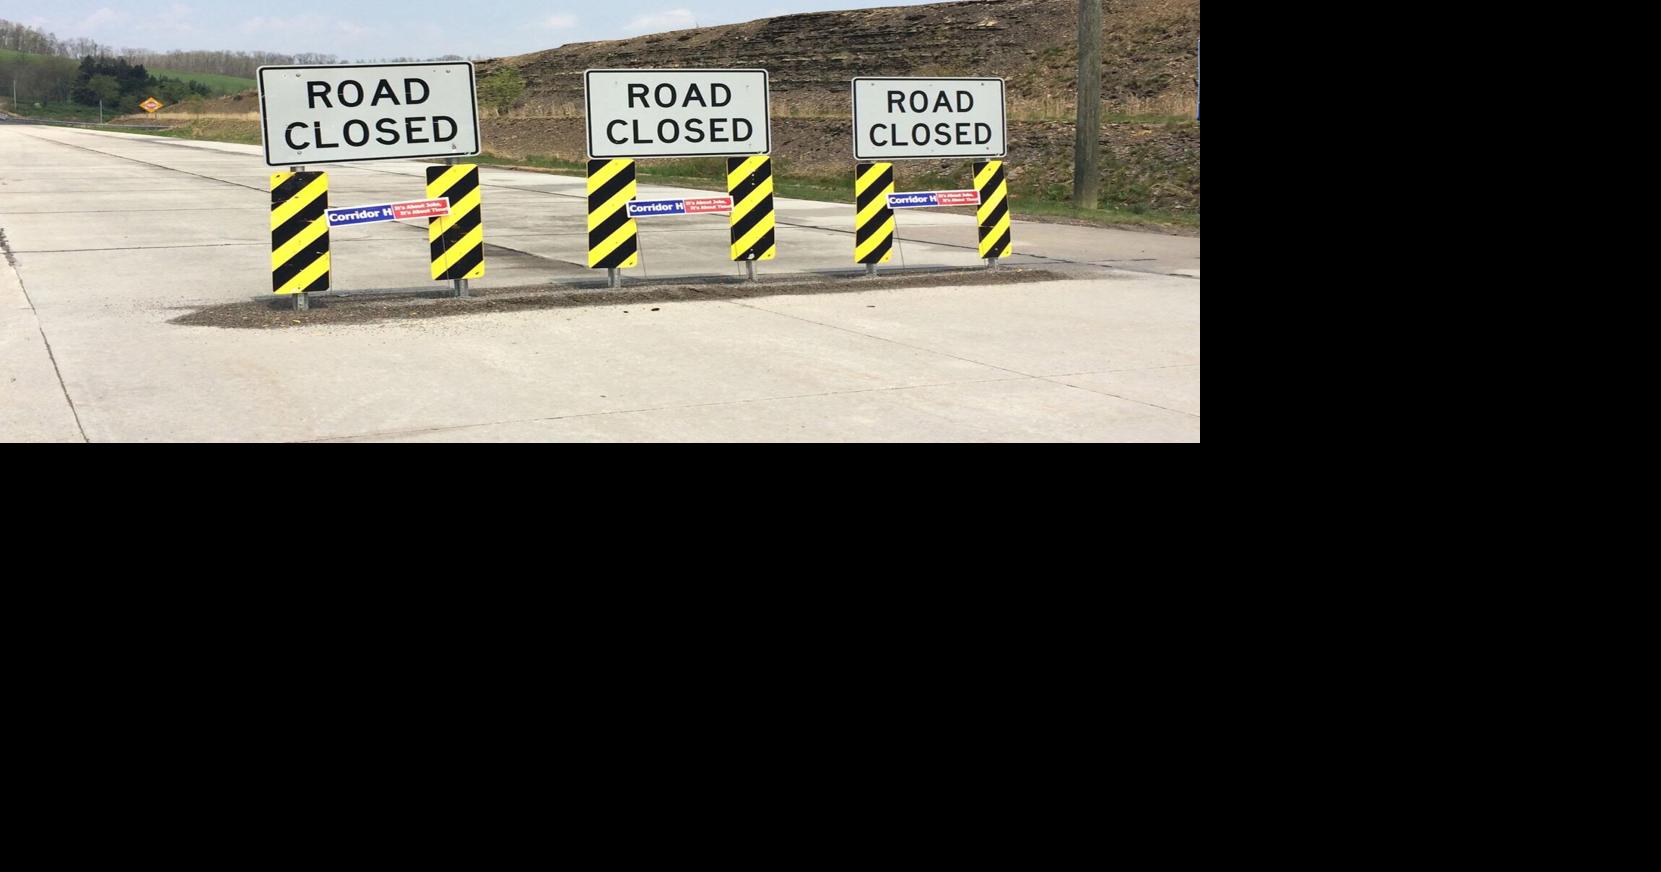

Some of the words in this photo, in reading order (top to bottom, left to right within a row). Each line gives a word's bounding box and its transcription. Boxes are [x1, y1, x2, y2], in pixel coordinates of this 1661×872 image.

[306, 77, 430, 109] ROAD
[627, 82, 732, 109] ROAD
[887, 90, 974, 113] ROAD
[284, 115, 458, 150] CLOSED
[606, 117, 753, 145] CLOSED
[869, 122, 992, 147] CLOSED
[629, 203, 673, 213] Corridor
[675, 202, 684, 210] H
[889, 195, 929, 204] Corridor
[329, 209, 380, 222] Corridor
[382, 208, 393, 217] H
